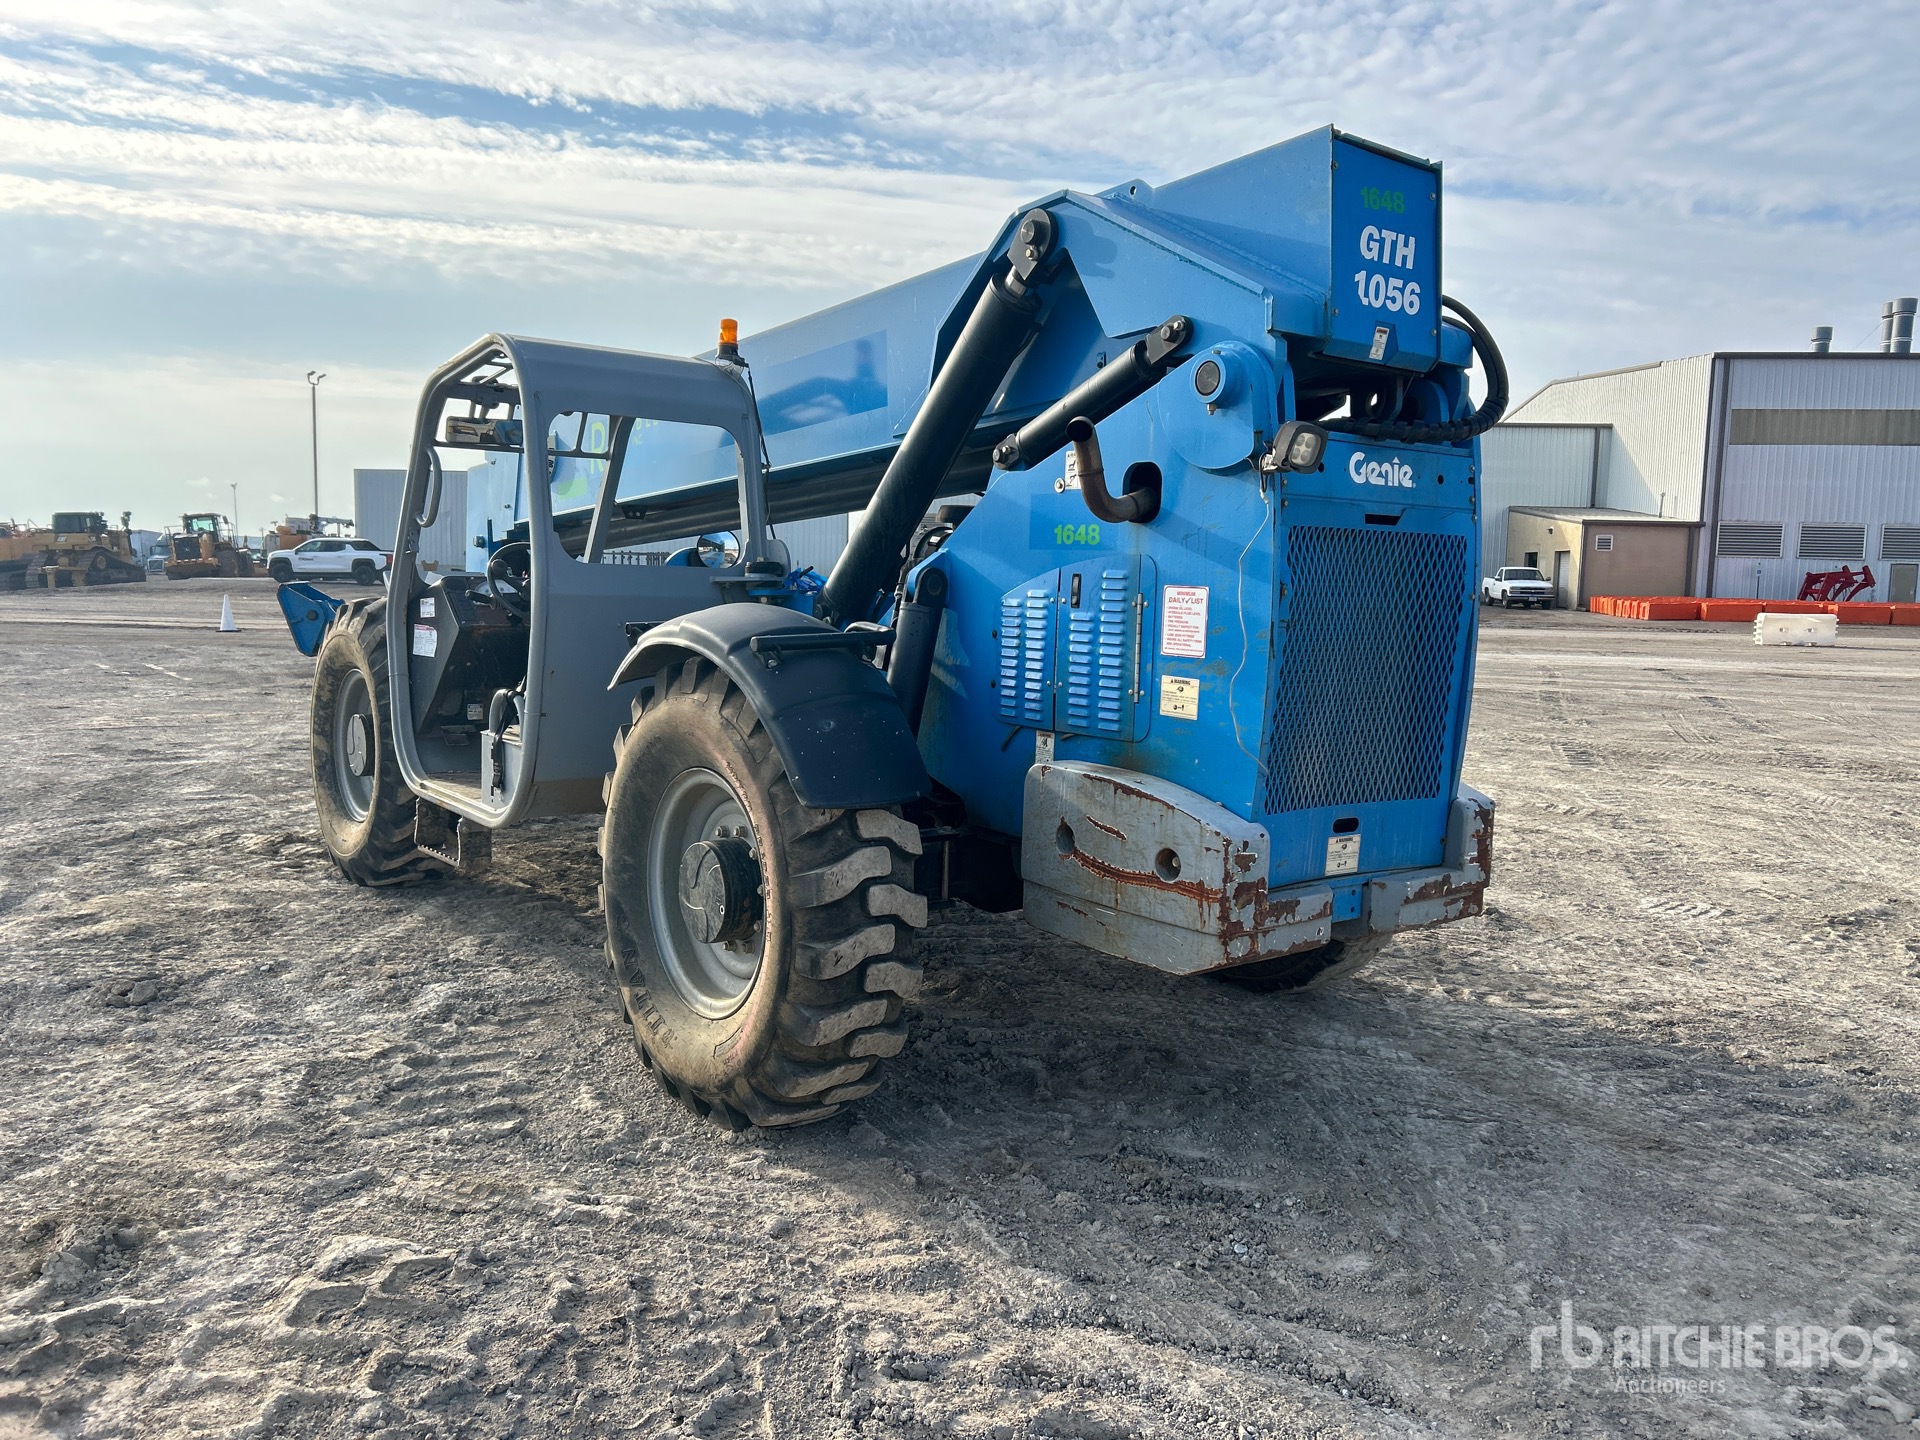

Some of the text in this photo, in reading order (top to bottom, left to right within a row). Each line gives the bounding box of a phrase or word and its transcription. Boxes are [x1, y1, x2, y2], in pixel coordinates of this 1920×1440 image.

[1361, 186, 1406, 214] 1648
[1360, 225, 1416, 270] GTH
[1354, 270, 1421, 316] 1056
[1349, 451, 1413, 488] Genie
[1054, 523, 1100, 545] 1648
[1168, 596, 1204, 605] DAILY LIST
